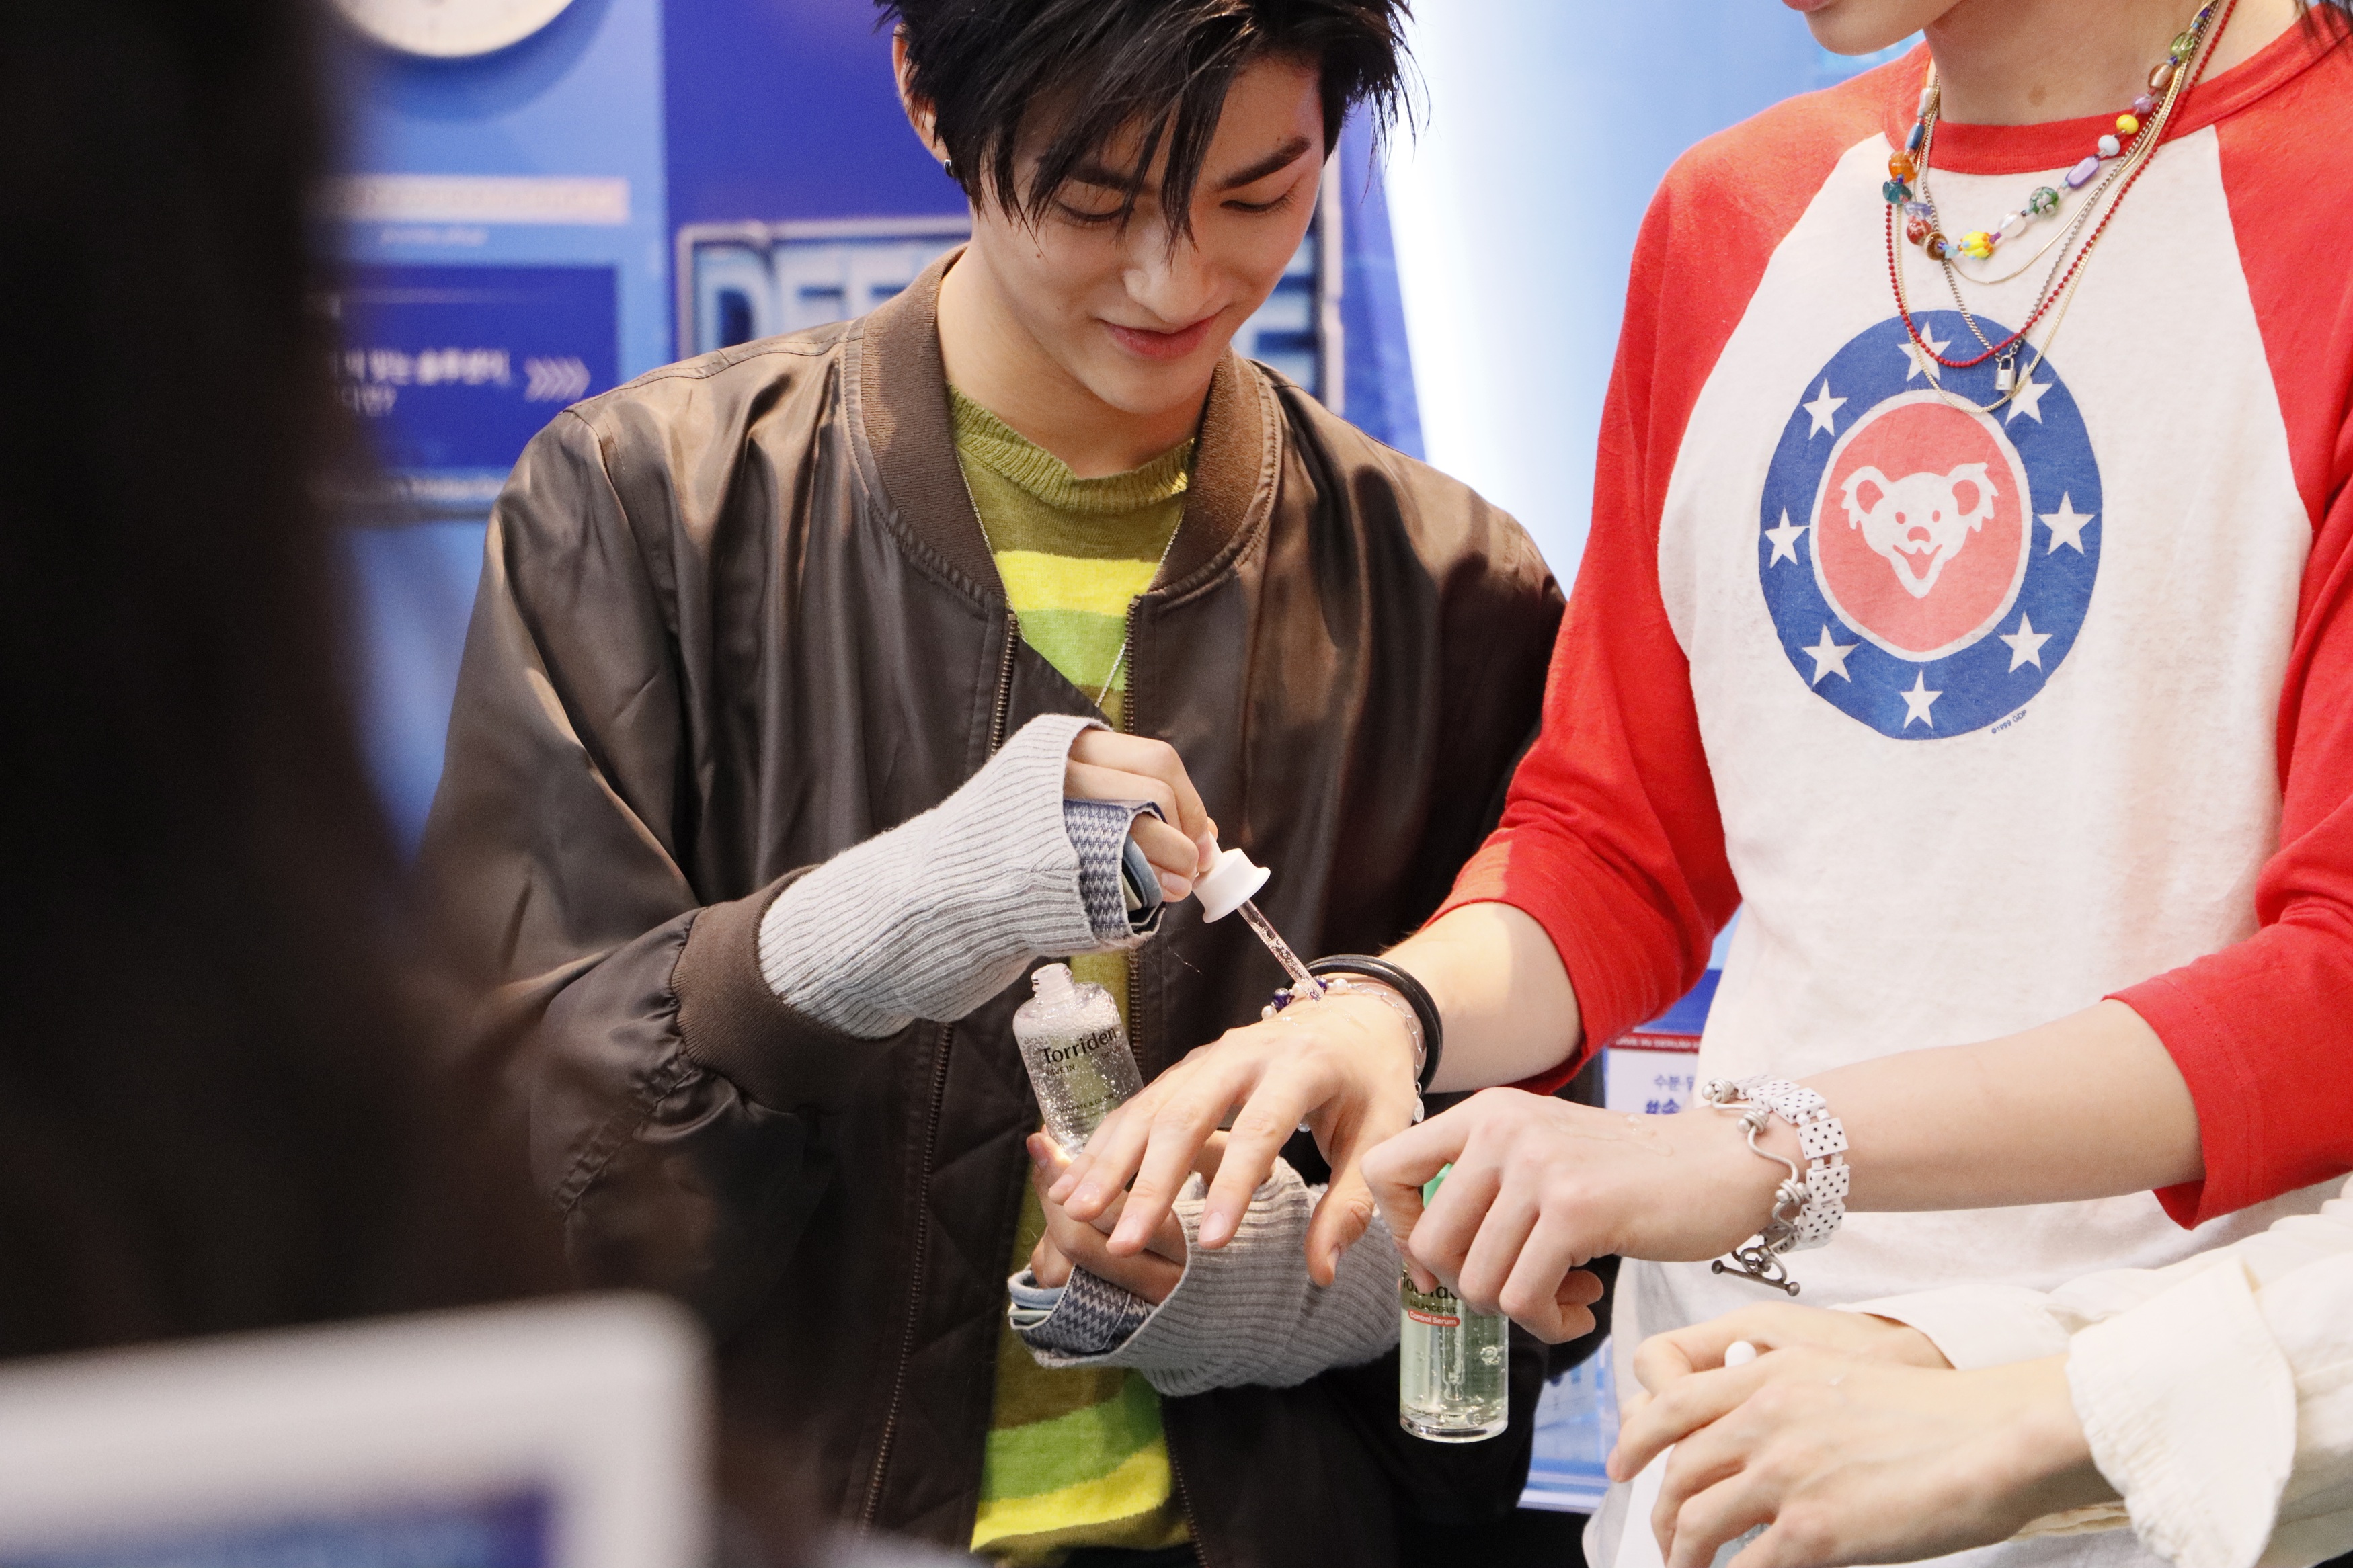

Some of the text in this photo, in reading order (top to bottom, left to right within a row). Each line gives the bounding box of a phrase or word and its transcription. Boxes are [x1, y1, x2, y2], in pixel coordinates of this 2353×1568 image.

[2012, 710, 2027, 723] GDP
[1040, 1028, 1117, 1063] Torriden
[1047, 1064, 1076, 1075] DIVE IN
[1409, 1311, 1457, 1325] Control Serum
